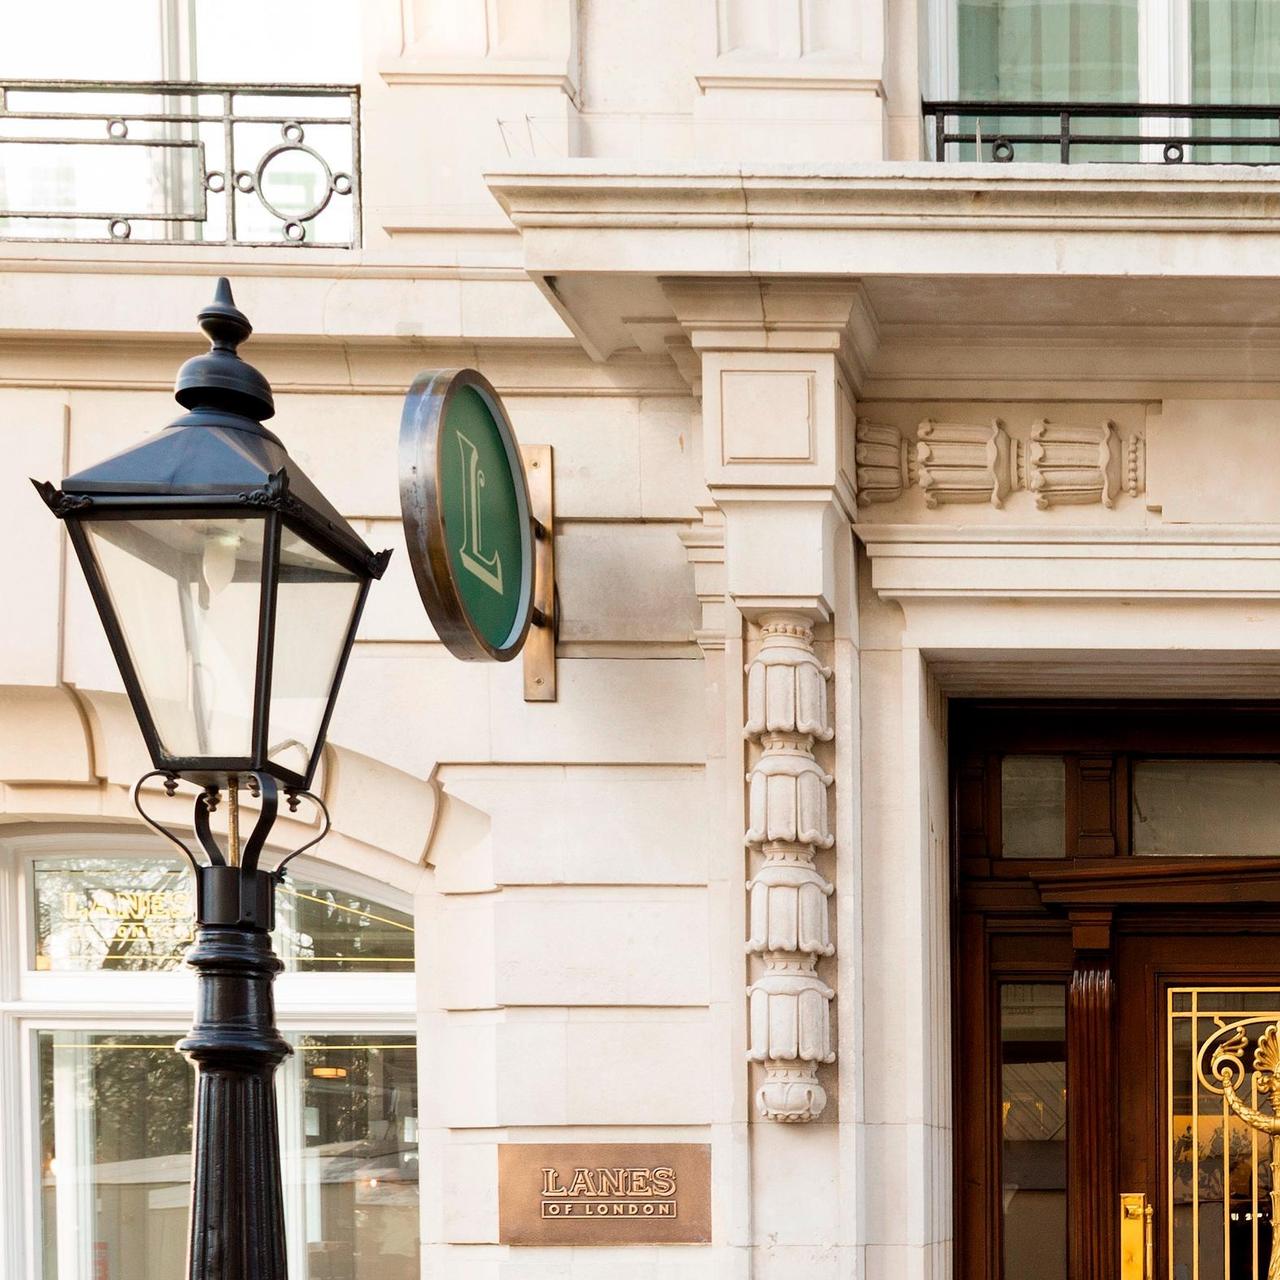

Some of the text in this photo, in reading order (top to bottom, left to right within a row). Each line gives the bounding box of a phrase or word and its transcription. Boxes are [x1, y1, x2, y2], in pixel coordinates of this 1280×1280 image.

[456, 429, 504, 595] L
[541, 1167, 676, 1197] LANES
[549, 1203, 671, 1215] OF LONDON
